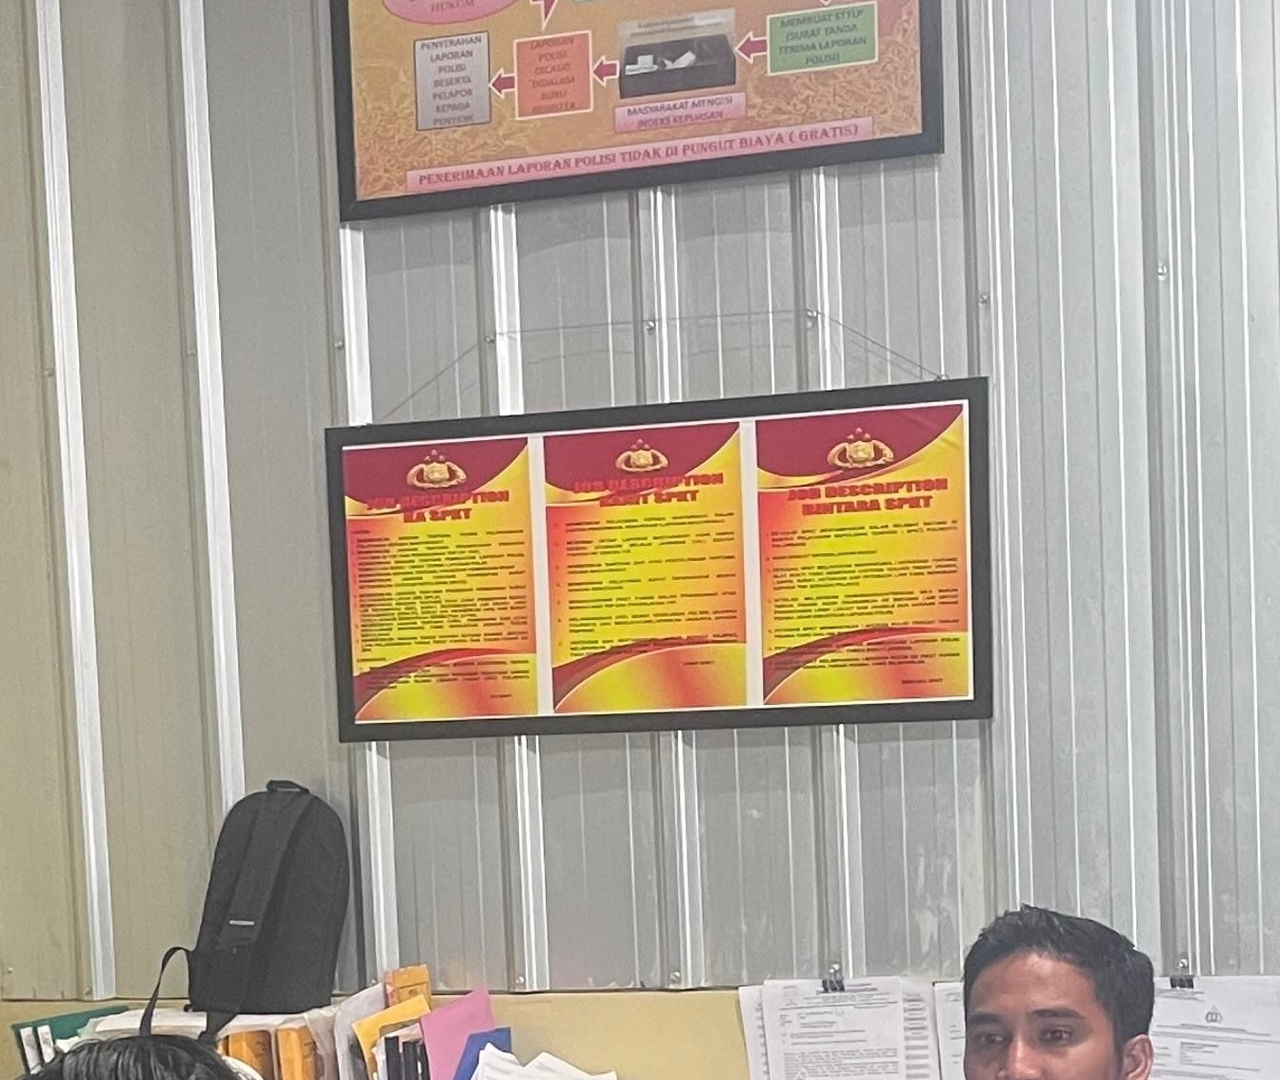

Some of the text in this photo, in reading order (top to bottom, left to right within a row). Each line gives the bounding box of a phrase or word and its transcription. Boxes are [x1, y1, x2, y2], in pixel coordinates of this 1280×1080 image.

[824, 24, 859, 36] TANDA
[421, 35, 482, 51] PENYERAHAN
[430, 50, 474, 63] LAPORAN
[438, 63, 467, 74] POLISI
[433, 77, 472, 88] BESERTA
[432, 88, 473, 101] PELAPOR
[436, 101, 471, 114] KEPADA
[627, 95, 734, 117] MASYARAKAT MENGISI
[433, 114, 475, 127] PENYIDIK
[637, 110, 724, 129] INDEKS KEPUASAN
[419, 166, 505, 185] PENERIMAAN
[508, 158, 571, 177] LAPORAN
[574, 153, 617, 169] POLISI
[619, 147, 662, 163] TIDAK
[665, 146, 679, 158] DI
[682, 139, 736, 156] PUNGUT
[739, 133, 785, 148] BIAYA
[824, 478, 949, 499] DESCRIPTION
